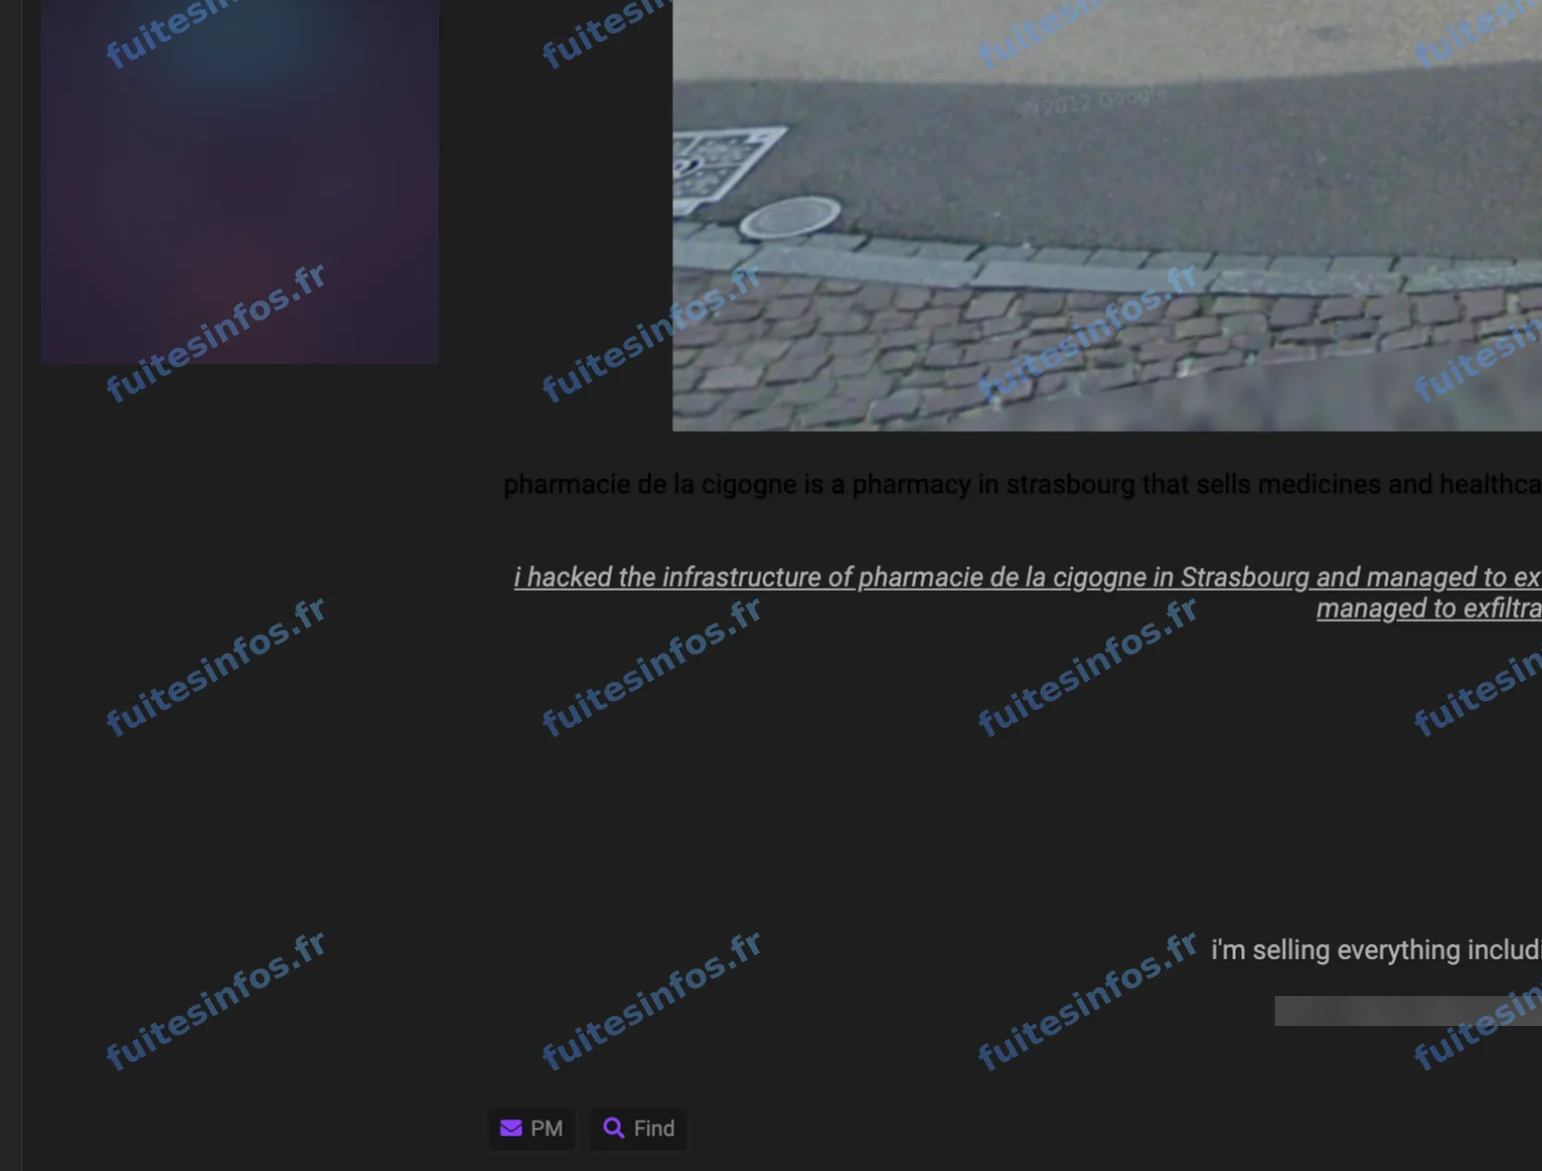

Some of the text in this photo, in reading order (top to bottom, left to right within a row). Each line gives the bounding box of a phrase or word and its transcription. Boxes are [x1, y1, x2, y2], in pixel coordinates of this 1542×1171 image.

[503, 471, 632, 501] pharmacie
[636, 470, 668, 496] de
[673, 471, 696, 496] la
[700, 472, 798, 501] cigogne
[803, 472, 825, 496] is
[830, 476, 846, 496] a
[852, 471, 973, 501] pharmacy
[977, 472, 1000, 496] in
[1005, 471, 1137, 501] strasbourg
[1140, 470, 1191, 496] that
[1195, 471, 1252, 496] sells
[1257, 471, 1383, 496] medicines
[1387, 470, 1434, 496] and
[513, 565, 523, 590] i
[526, 564, 614, 590] hacked
[618, 564, 657, 590] the
[661, 563, 823, 590] infrastructure
[827, 563, 857, 590] of
[857, 564, 985, 594] pharmacie
[989, 564, 1021, 590] de
[1024, 564, 1047, 590] la
[1052, 565, 1148, 594] cigogne
[1152, 565, 1175, 590] in
[1180, 564, 1311, 594] Strasbourg
[1315, 564, 1363, 590] and
[1366, 564, 1479, 594] managed
[1483, 566, 1508, 590] to
[1315, 595, 1429, 625] managed
[1433, 597, 1458, 621] to
[1211, 937, 1247, 961] i'm
[1252, 936, 1331, 967] selling
[1337, 936, 1461, 967] everything
[530, 1118, 564, 1138] PM
[633, 1117, 676, 1138] Find
